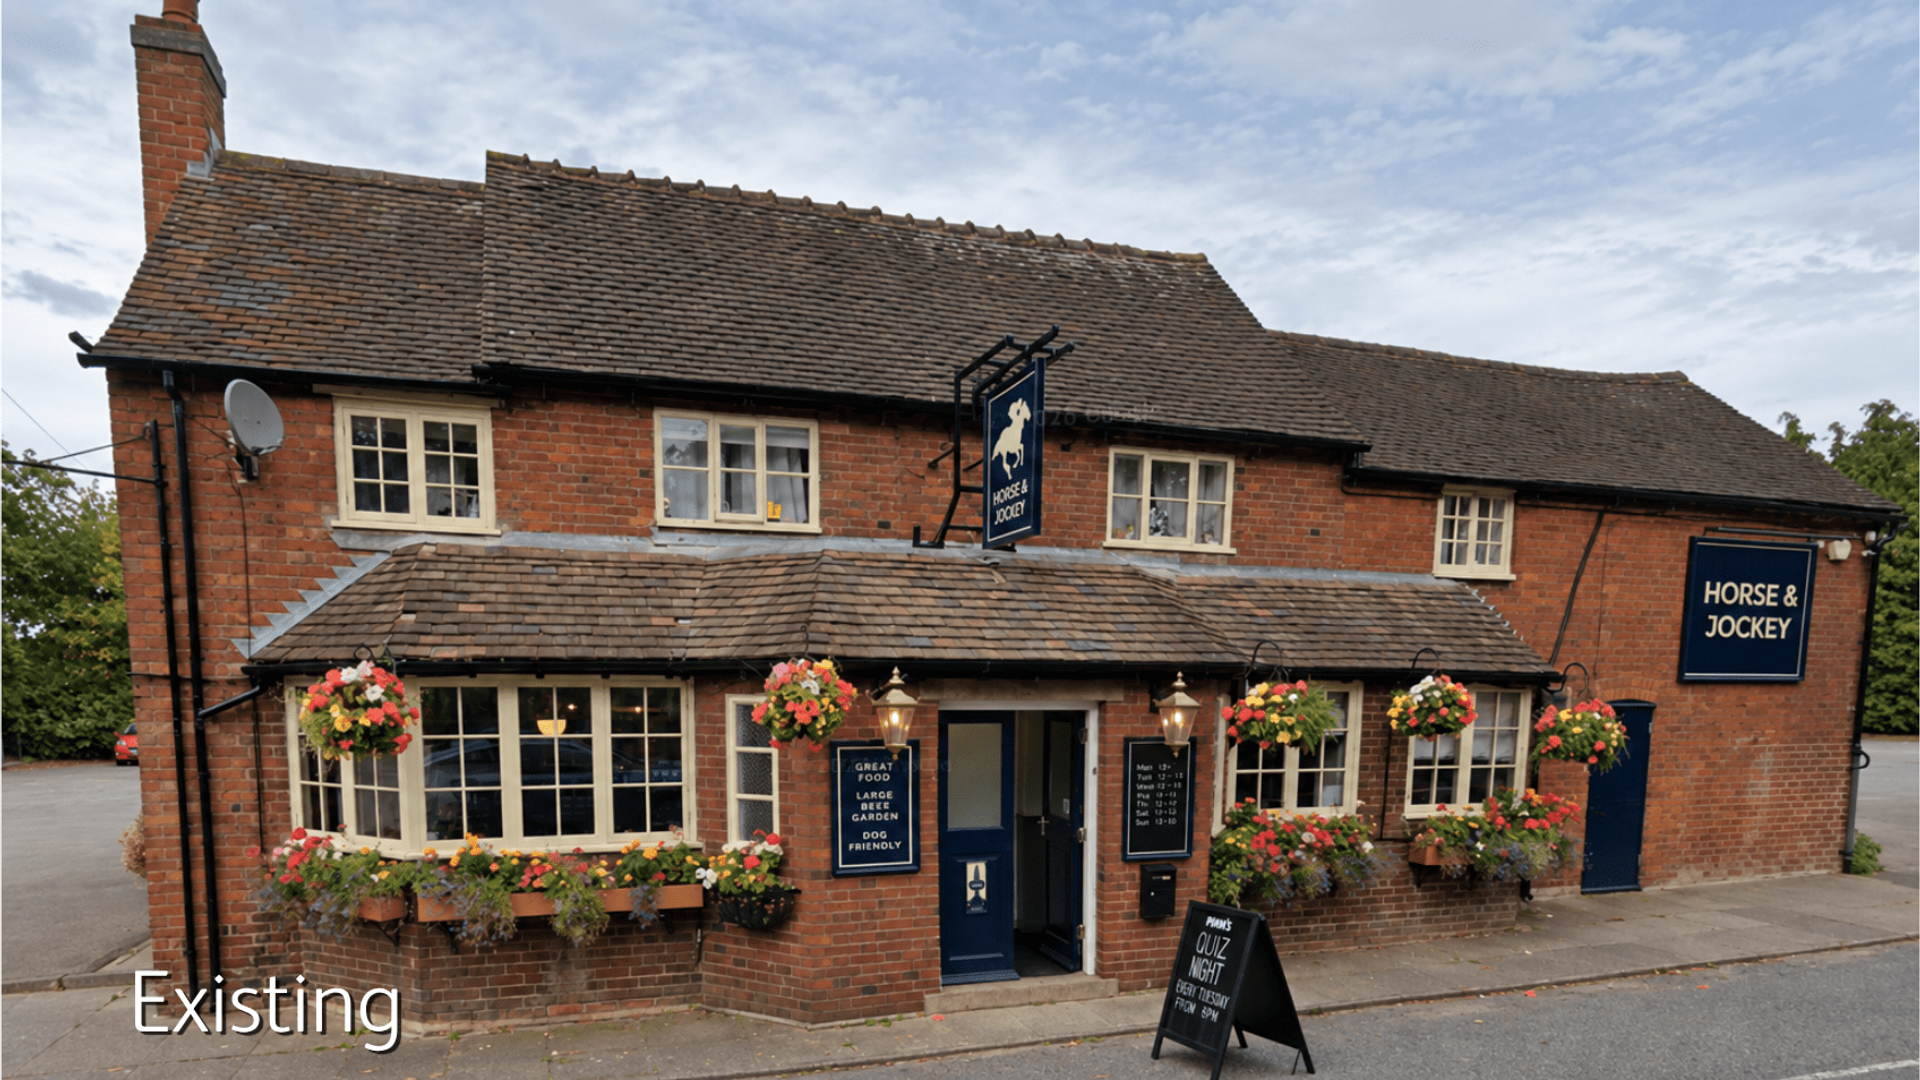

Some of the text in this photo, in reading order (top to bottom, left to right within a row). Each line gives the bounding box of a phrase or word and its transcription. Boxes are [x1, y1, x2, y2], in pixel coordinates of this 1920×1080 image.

[993, 479, 1029, 506] HORSE &
[1704, 581, 1798, 607] HORSE &
[1705, 615, 1792, 640] JOCKEY
[855, 762, 893, 772] GREAT
[858, 773, 890, 782] FOOD
[856, 791, 893, 800] LARGE
[852, 812, 899, 822] GARDEN
[862, 831, 887, 840] DOG
[848, 841, 902, 851] FRIENDLY
[1196, 931, 1231, 960] QUIZ
[1188, 955, 1225, 986] NIGHT
[1176, 978, 1230, 1010] EVERY TUESDAY
